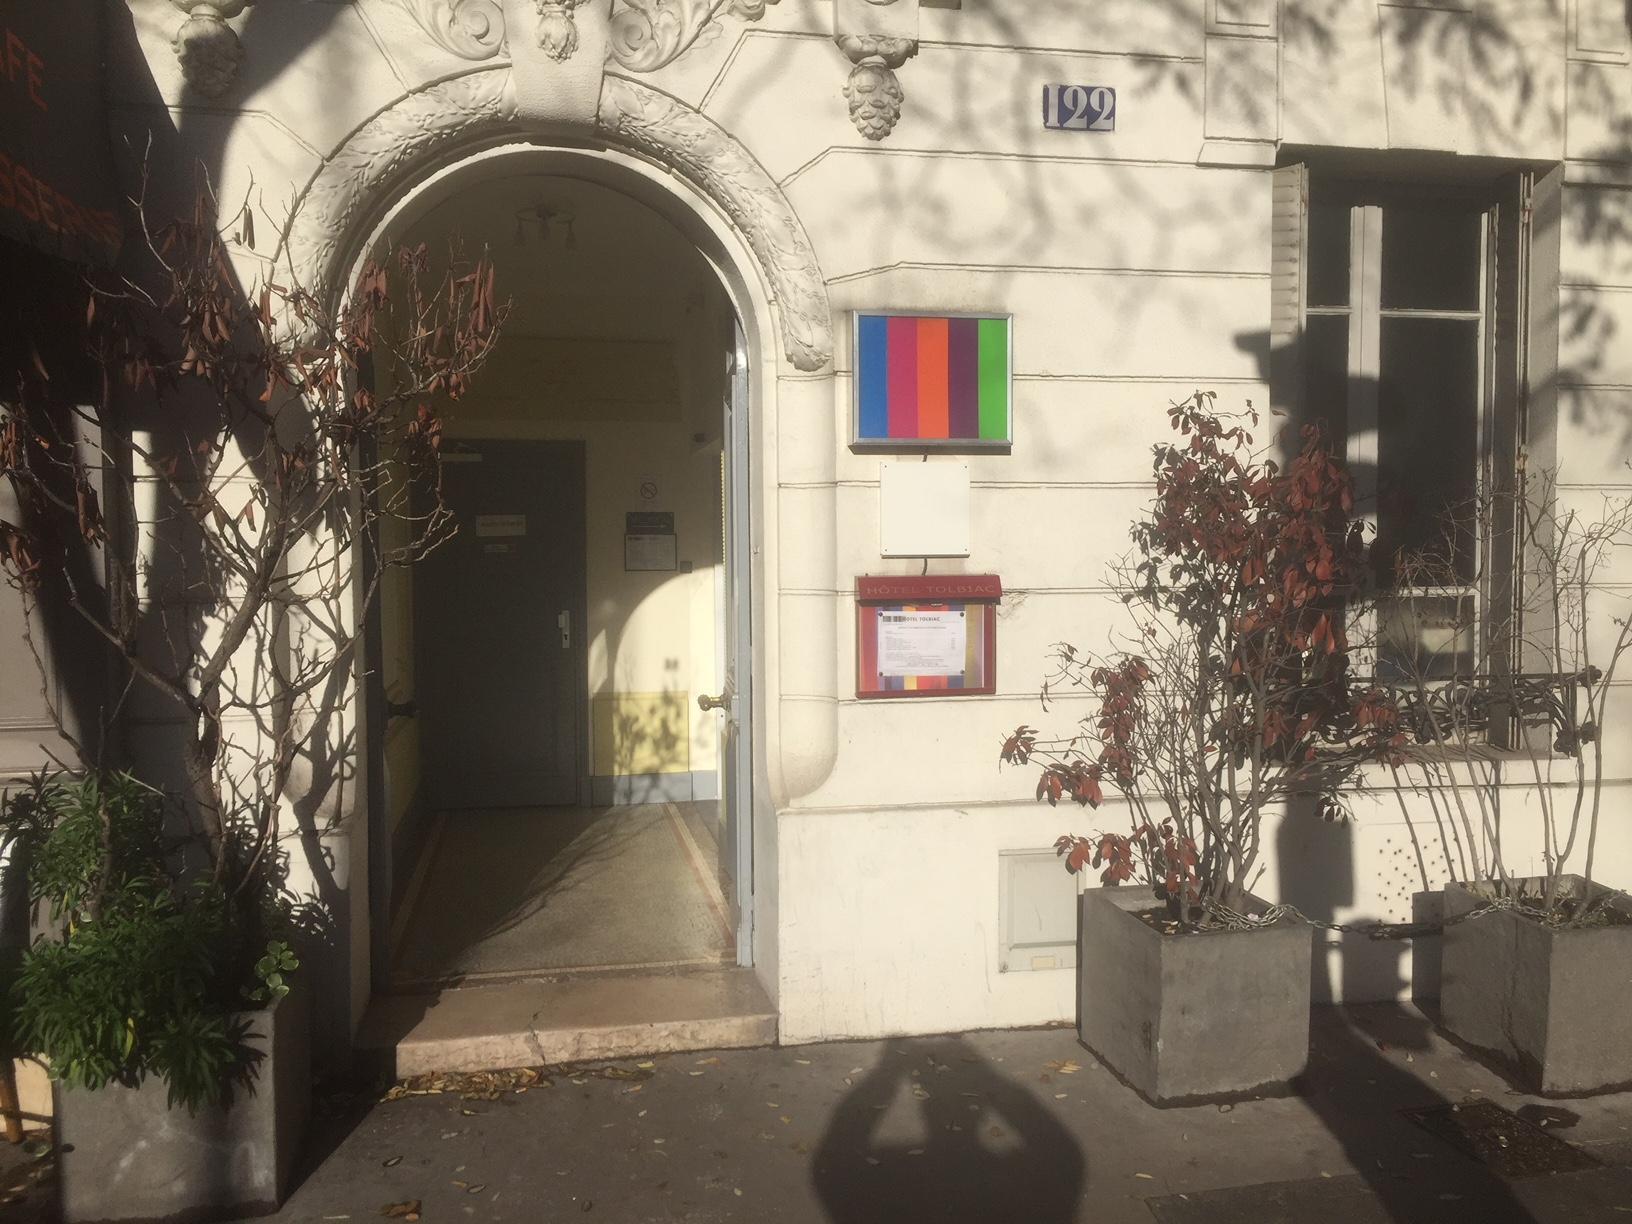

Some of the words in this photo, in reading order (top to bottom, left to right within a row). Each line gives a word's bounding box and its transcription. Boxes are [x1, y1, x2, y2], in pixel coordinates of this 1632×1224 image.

[1046, 83, 1114, 130] 122
[866, 584, 921, 594] HÔTEL
[926, 584, 995, 593] TOLBIAC
